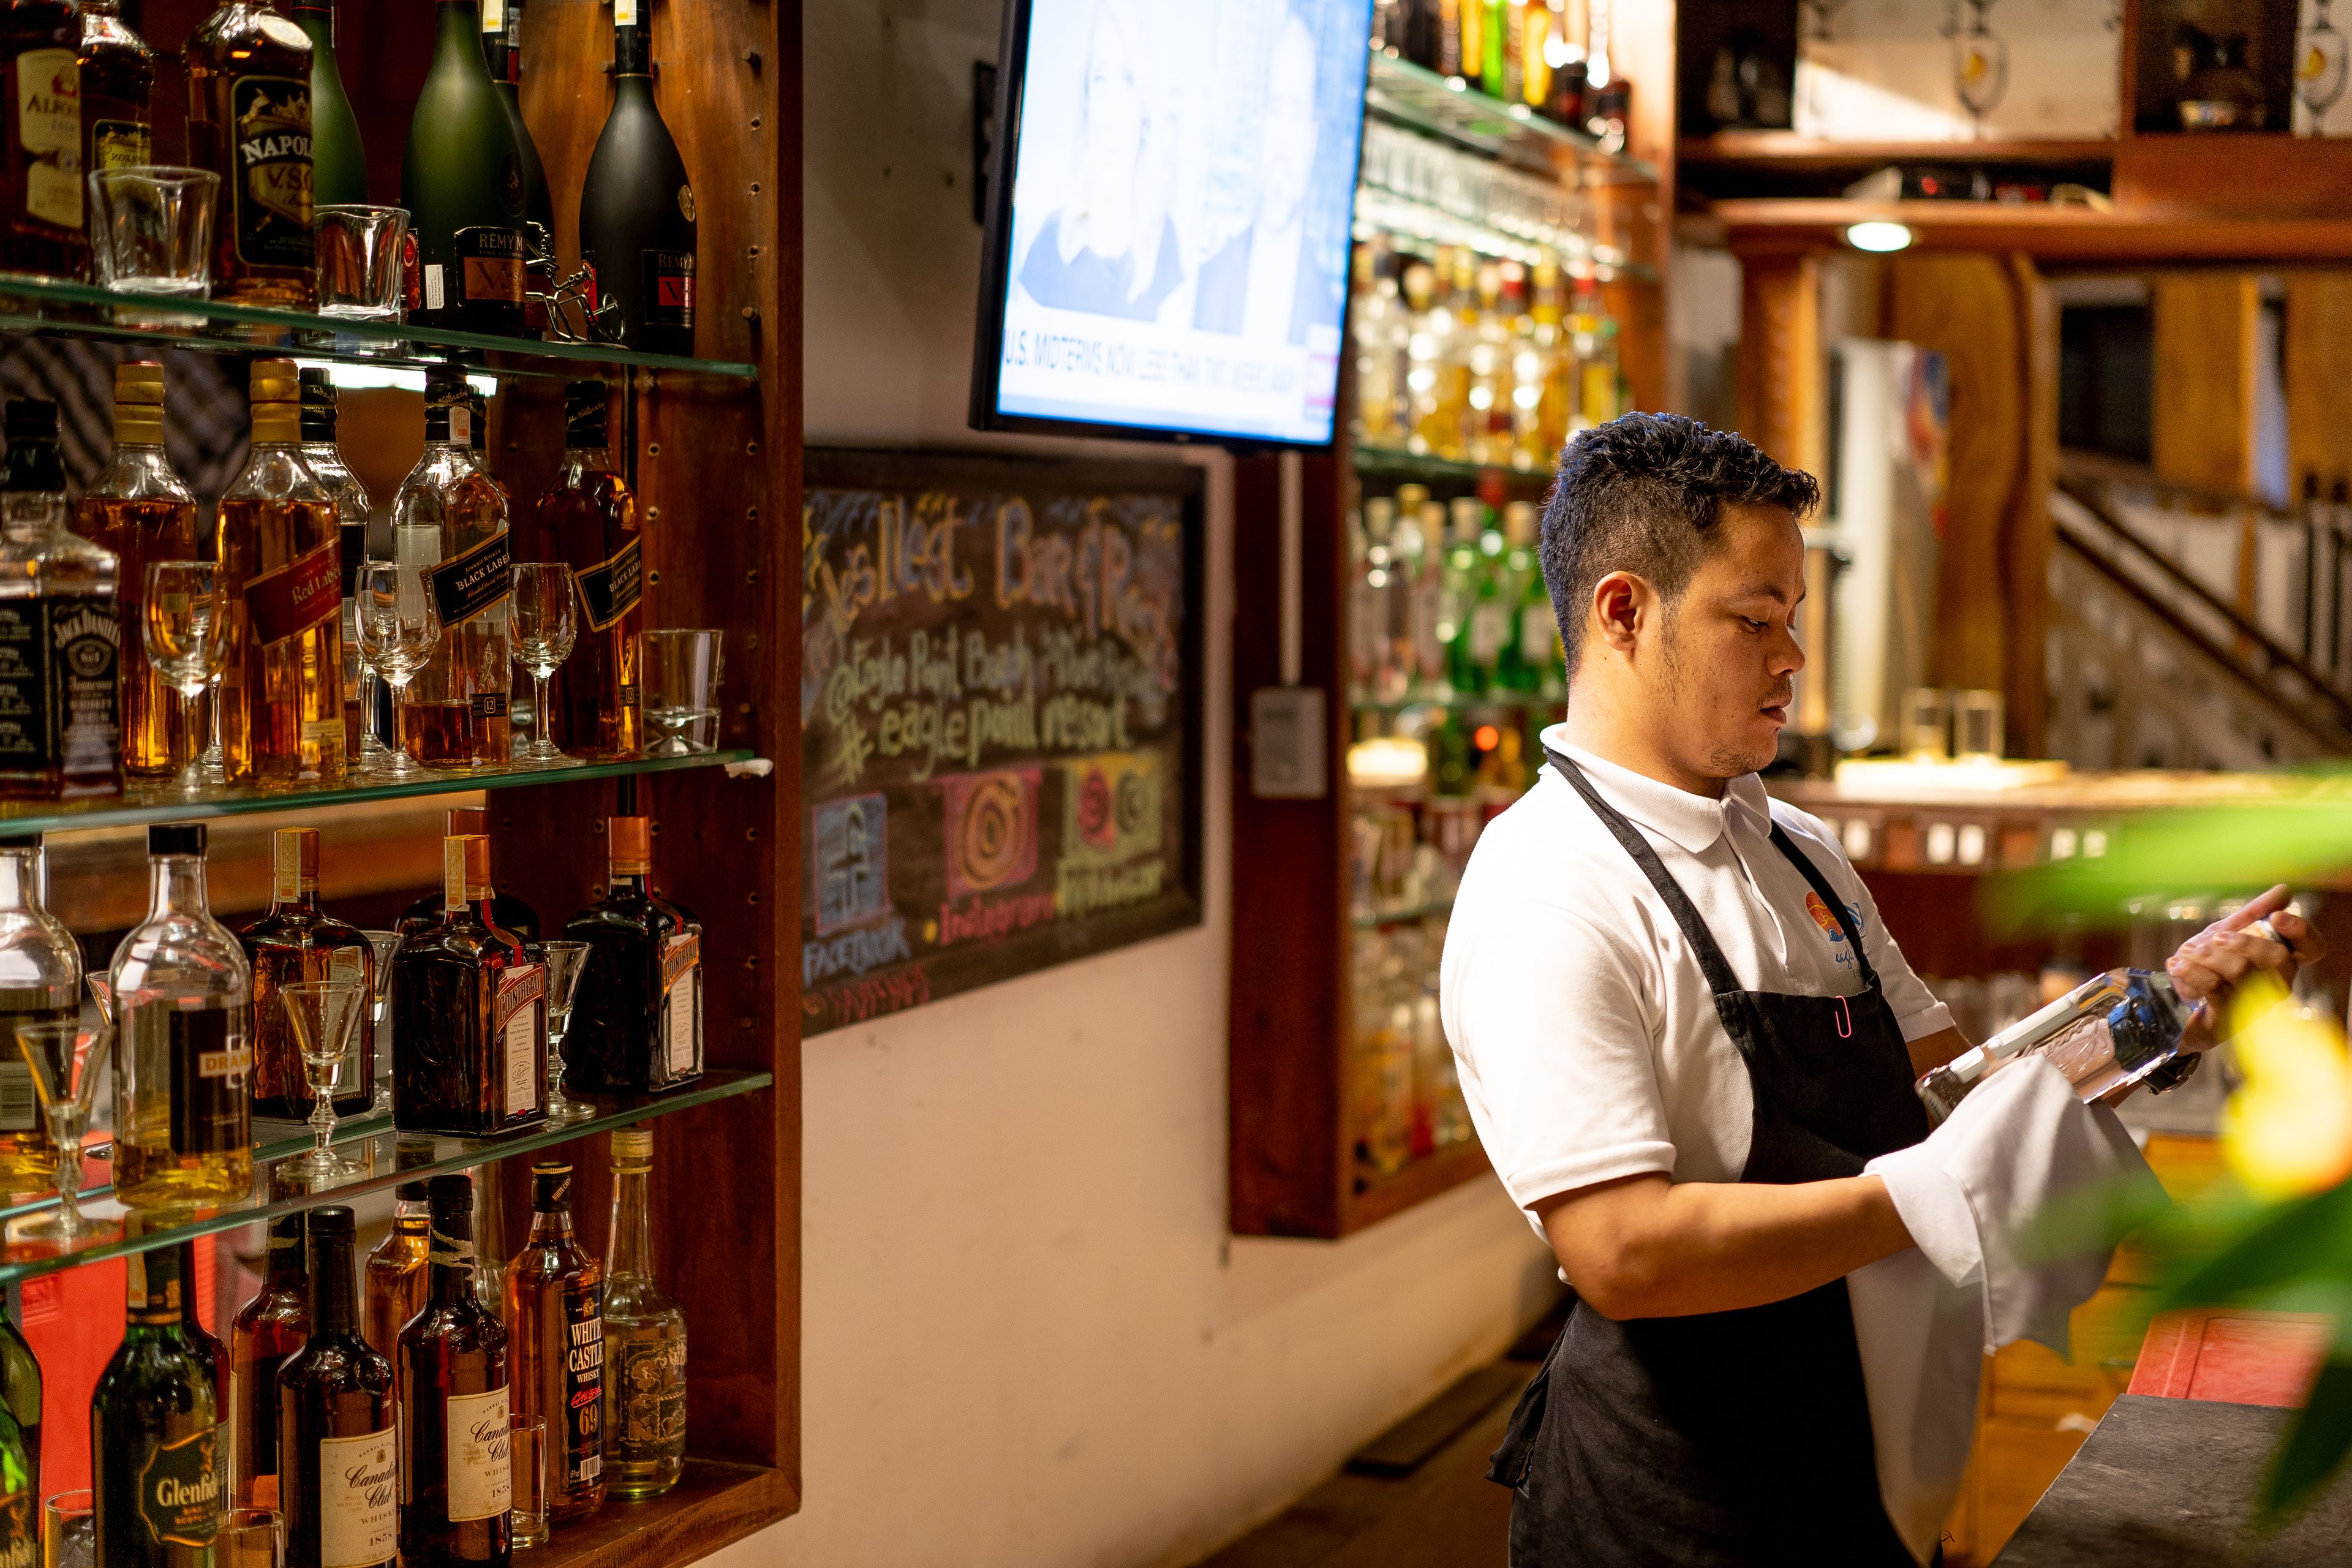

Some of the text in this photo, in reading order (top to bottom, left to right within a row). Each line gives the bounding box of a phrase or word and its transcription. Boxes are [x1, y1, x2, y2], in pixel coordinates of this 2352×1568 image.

[479, 232, 514, 250] RÉMY
[1003, 329, 1028, 366] U.S.
[1035, 333, 1102, 374] MIDTERMS
[466, 549, 501, 574] JOHNNIE WALKER
[292, 579, 315, 605] Red
[315, 562, 342, 590] Label
[455, 568, 486, 591] BLACK
[609, 571, 628, 593] BLACK
[486, 699, 494, 710] 12
[628, 690, 633, 700] 12
[665, 941, 698, 986] COINTREAU
[499, 973, 540, 1024] COINTREAU
[551, 1186, 565, 1200] WHITE
[570, 1316, 601, 1346] WHITE
[569, 1341, 603, 1373] CASTLE
[576, 1368, 600, 1384] WHISKY
[482, 1401, 500, 1414] BARREL
[579, 1403, 598, 1436] 69
